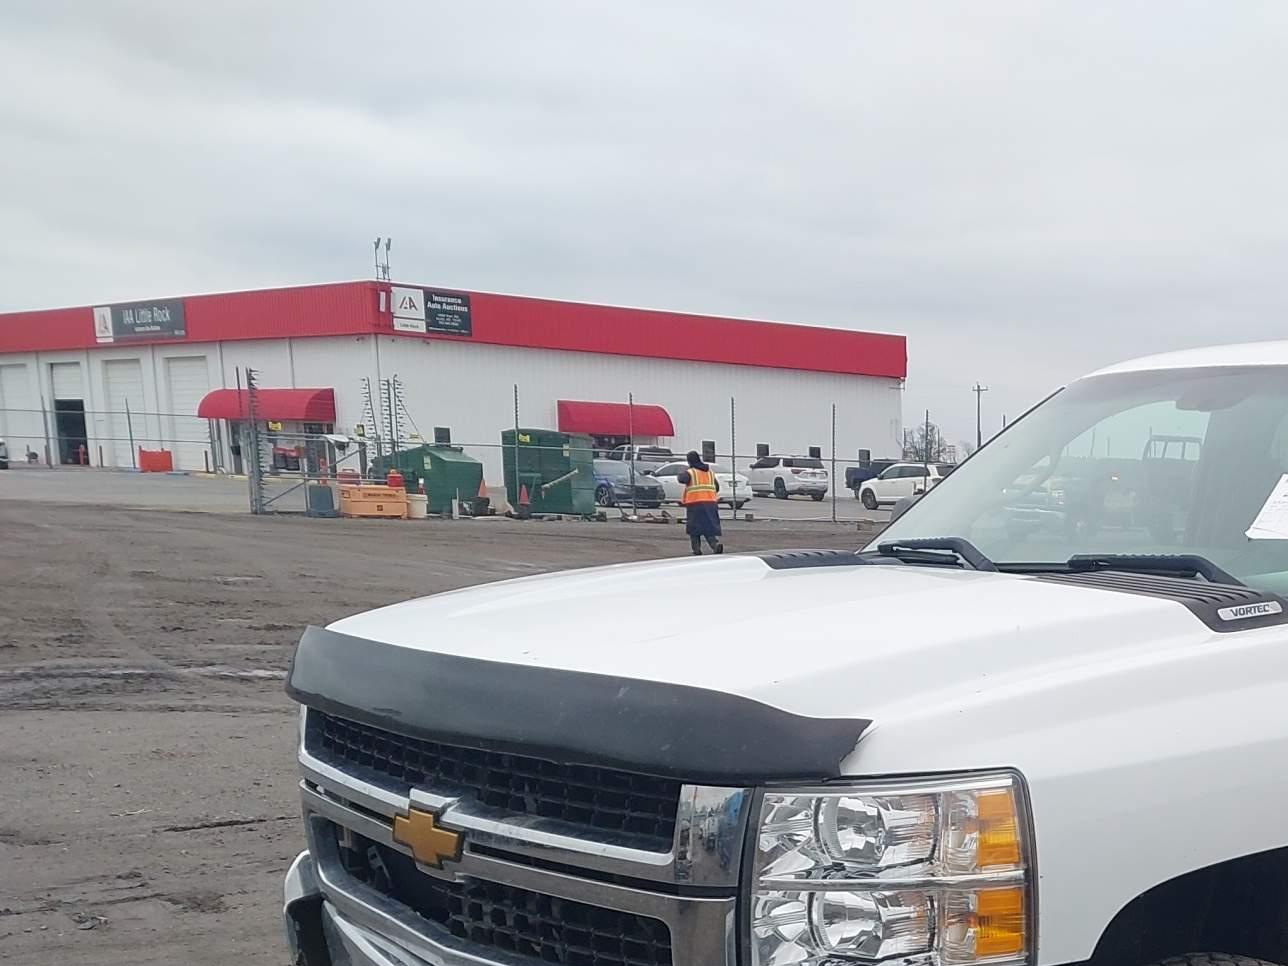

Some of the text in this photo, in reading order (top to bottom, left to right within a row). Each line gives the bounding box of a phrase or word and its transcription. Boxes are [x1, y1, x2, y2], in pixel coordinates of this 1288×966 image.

[432, 294, 462, 304] Insurance
[442, 303, 468, 312] Auctions
[135, 308, 152, 324] Little
[153, 306, 171, 322] Rock
[1231, 604, 1270, 617] VORTEC
